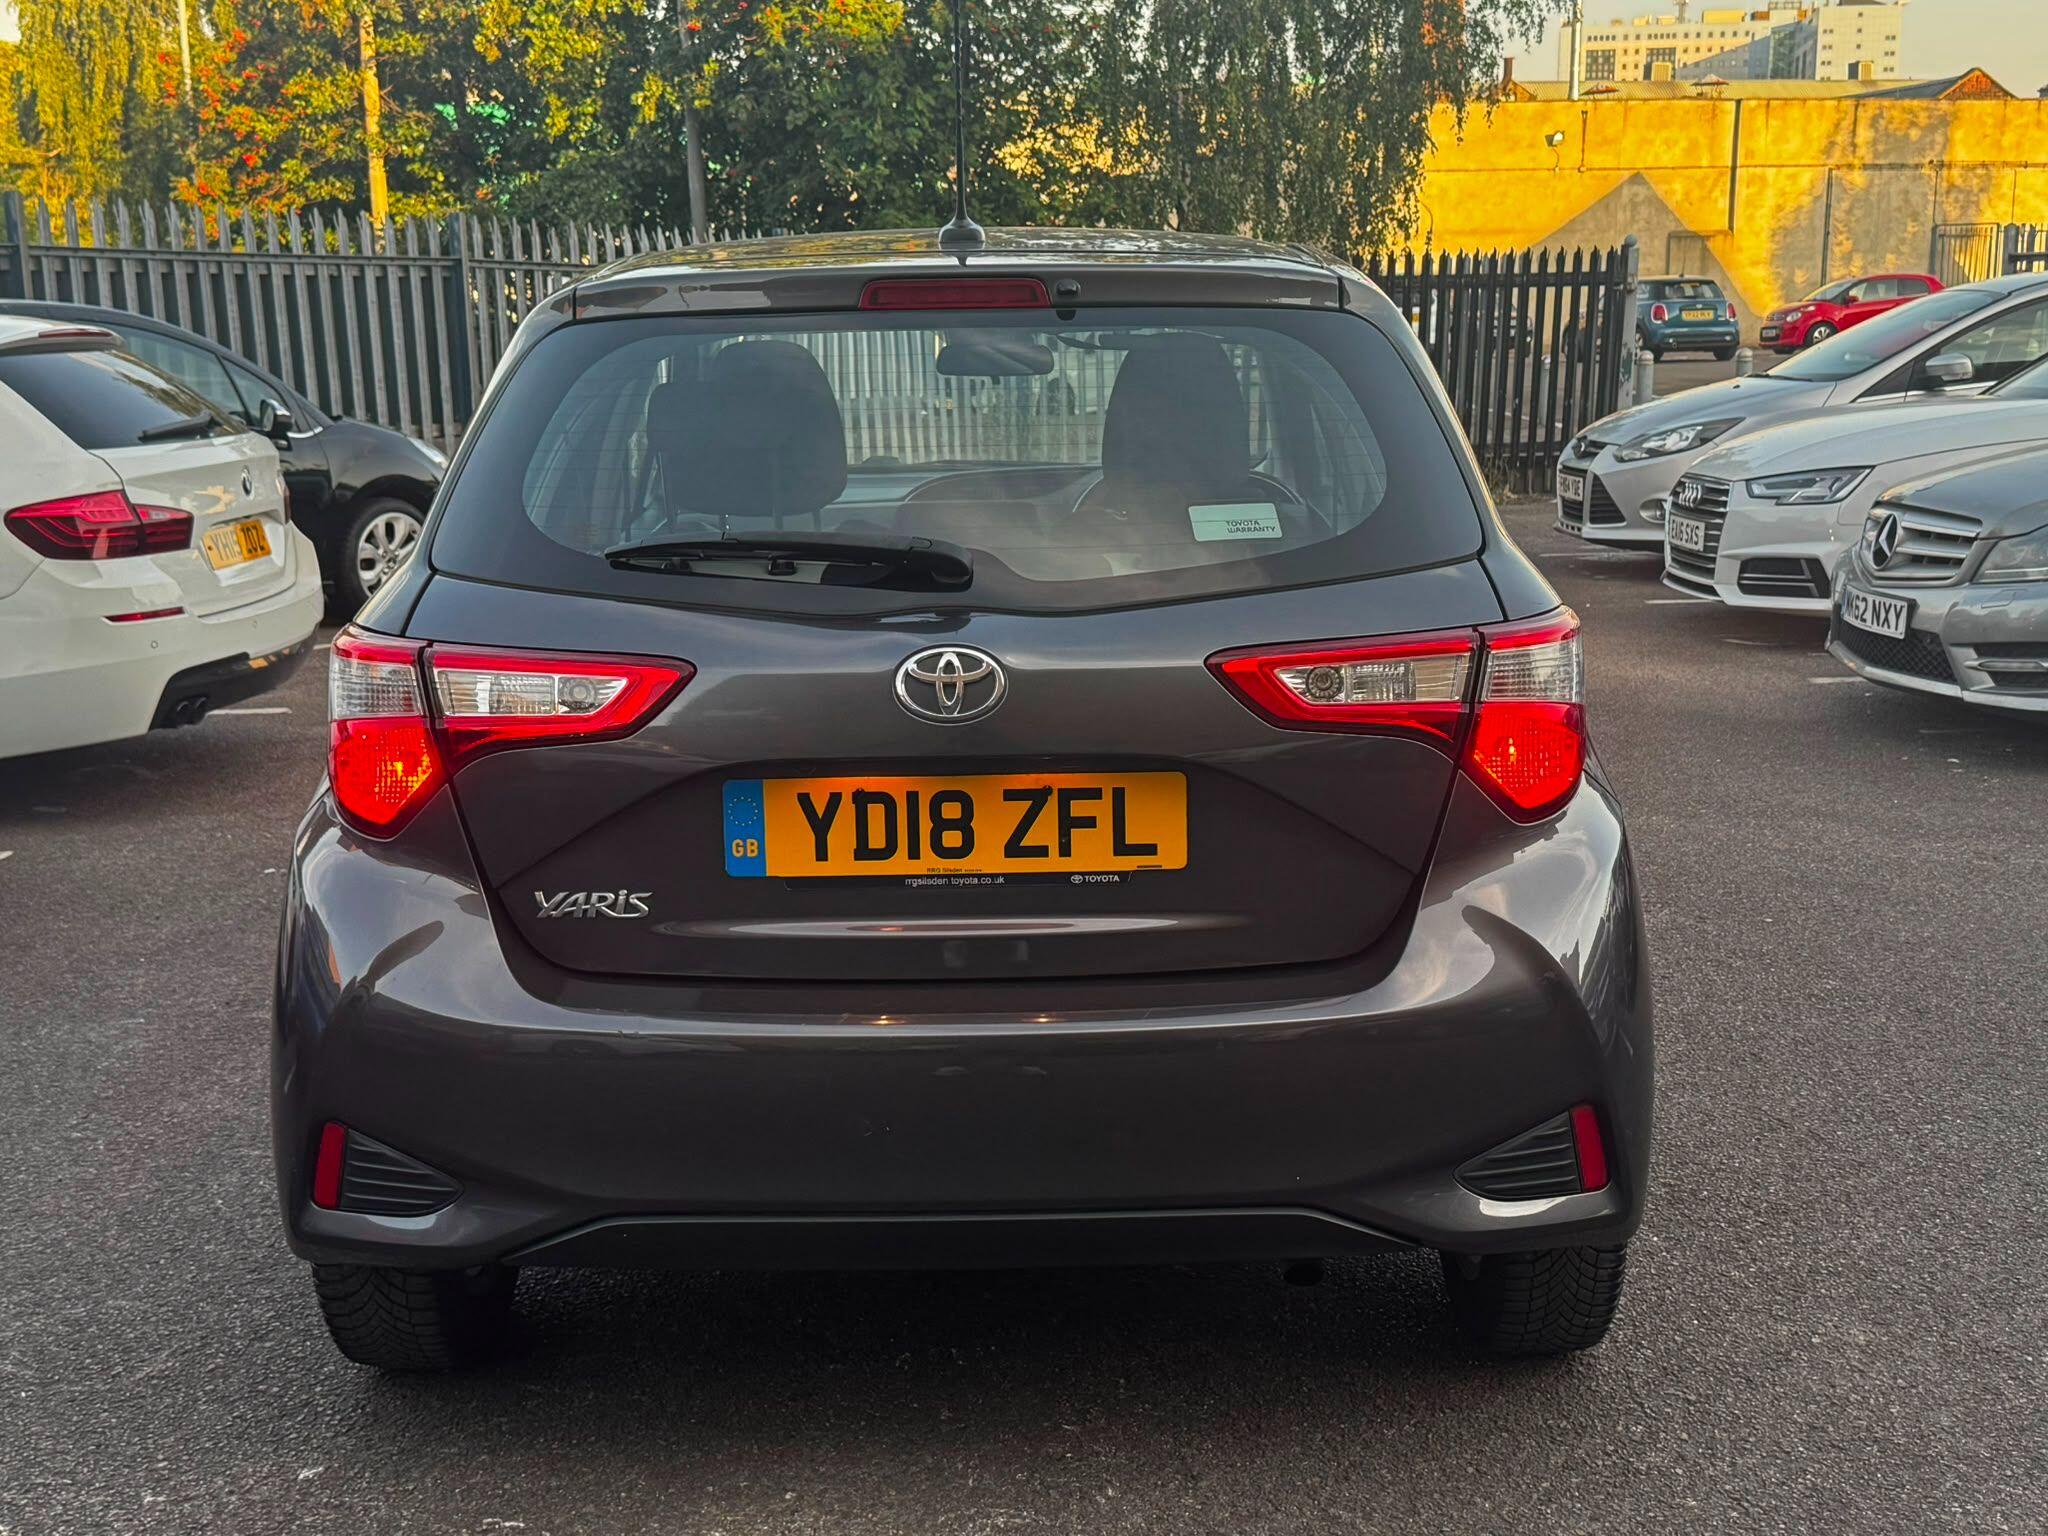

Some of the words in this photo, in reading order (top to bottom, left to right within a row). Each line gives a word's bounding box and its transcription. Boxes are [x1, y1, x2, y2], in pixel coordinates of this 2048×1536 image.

[1685, 522, 1700, 546] SXS
[1871, 599, 1905, 631] NXY
[797, 789, 975, 861] YD18
[1003, 787, 1158, 858] ZFL
[732, 839, 758, 857] GB
[951, 876, 1005, 886] toyota.co.uk
[1084, 875, 1120, 883] TOYOTA
